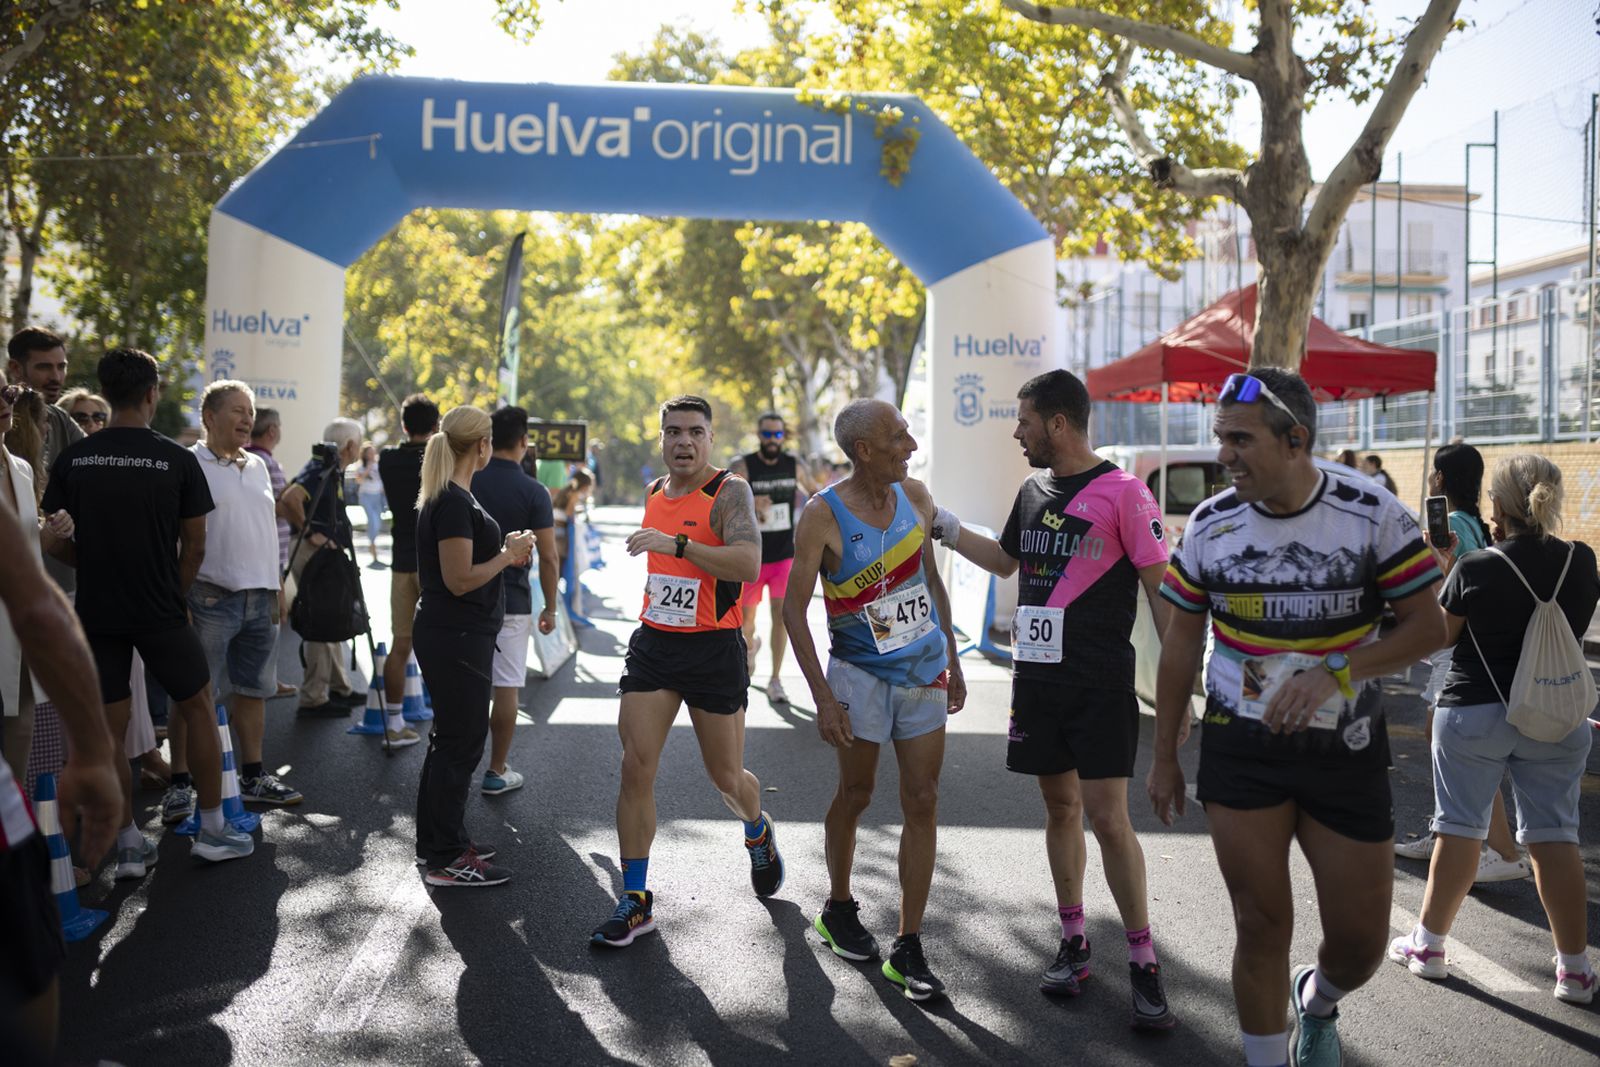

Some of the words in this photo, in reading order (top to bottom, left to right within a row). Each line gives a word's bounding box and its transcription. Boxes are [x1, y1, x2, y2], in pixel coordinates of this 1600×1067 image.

[422, 98, 630, 157] Huelva
[652, 109, 852, 175] original
[213, 309, 301, 336] Huelva
[954, 333, 1041, 356] Huelva
[249, 386, 297, 400] UELVA
[989, 407, 1017, 418] HUE
[72, 454, 169, 471] mastertrainers.es
[1052, 532, 1105, 561] FLATO
[854, 561, 886, 589] CLUB
[660, 585, 695, 610] 242
[896, 595, 929, 624] 475
[1029, 618, 1053, 642] 50
